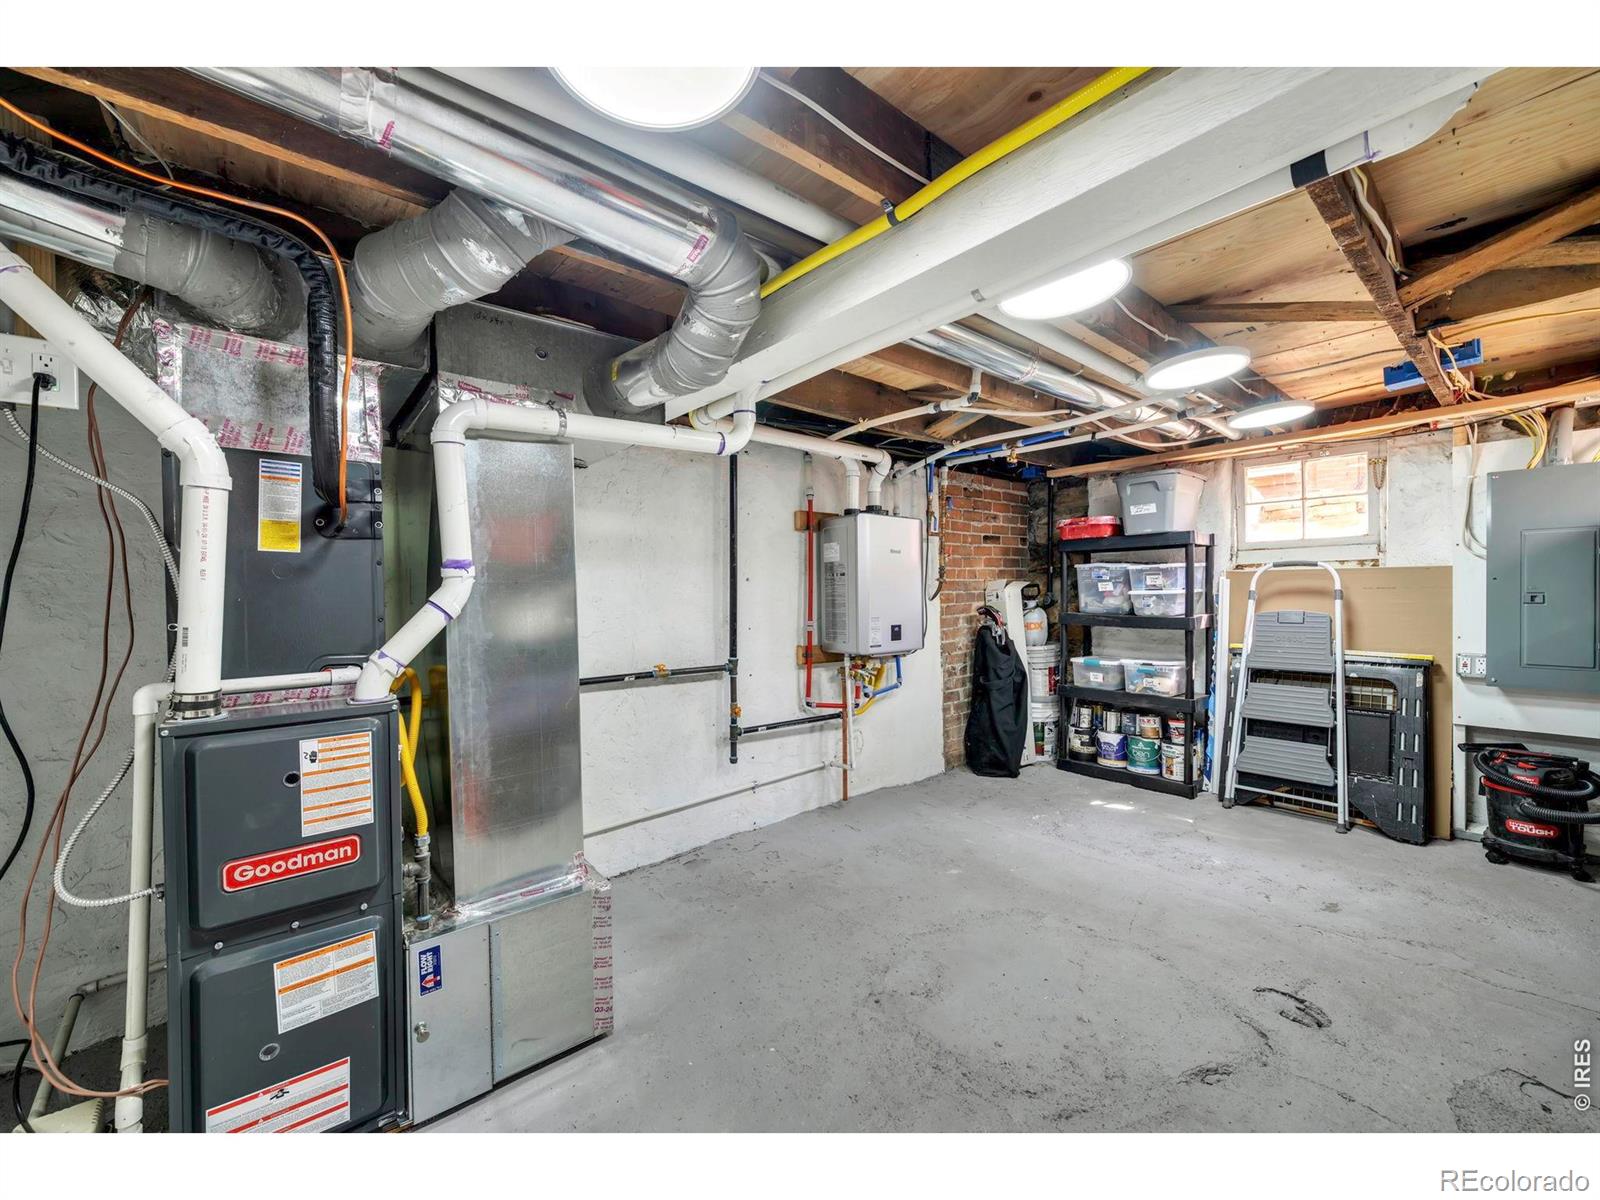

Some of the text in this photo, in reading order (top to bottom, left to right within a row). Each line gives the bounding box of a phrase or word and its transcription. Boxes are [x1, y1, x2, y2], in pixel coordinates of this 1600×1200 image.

[1511, 824, 1554, 837] TOUGH
[233, 845, 352, 881] Goodman
[420, 954, 428, 976] FLOW
